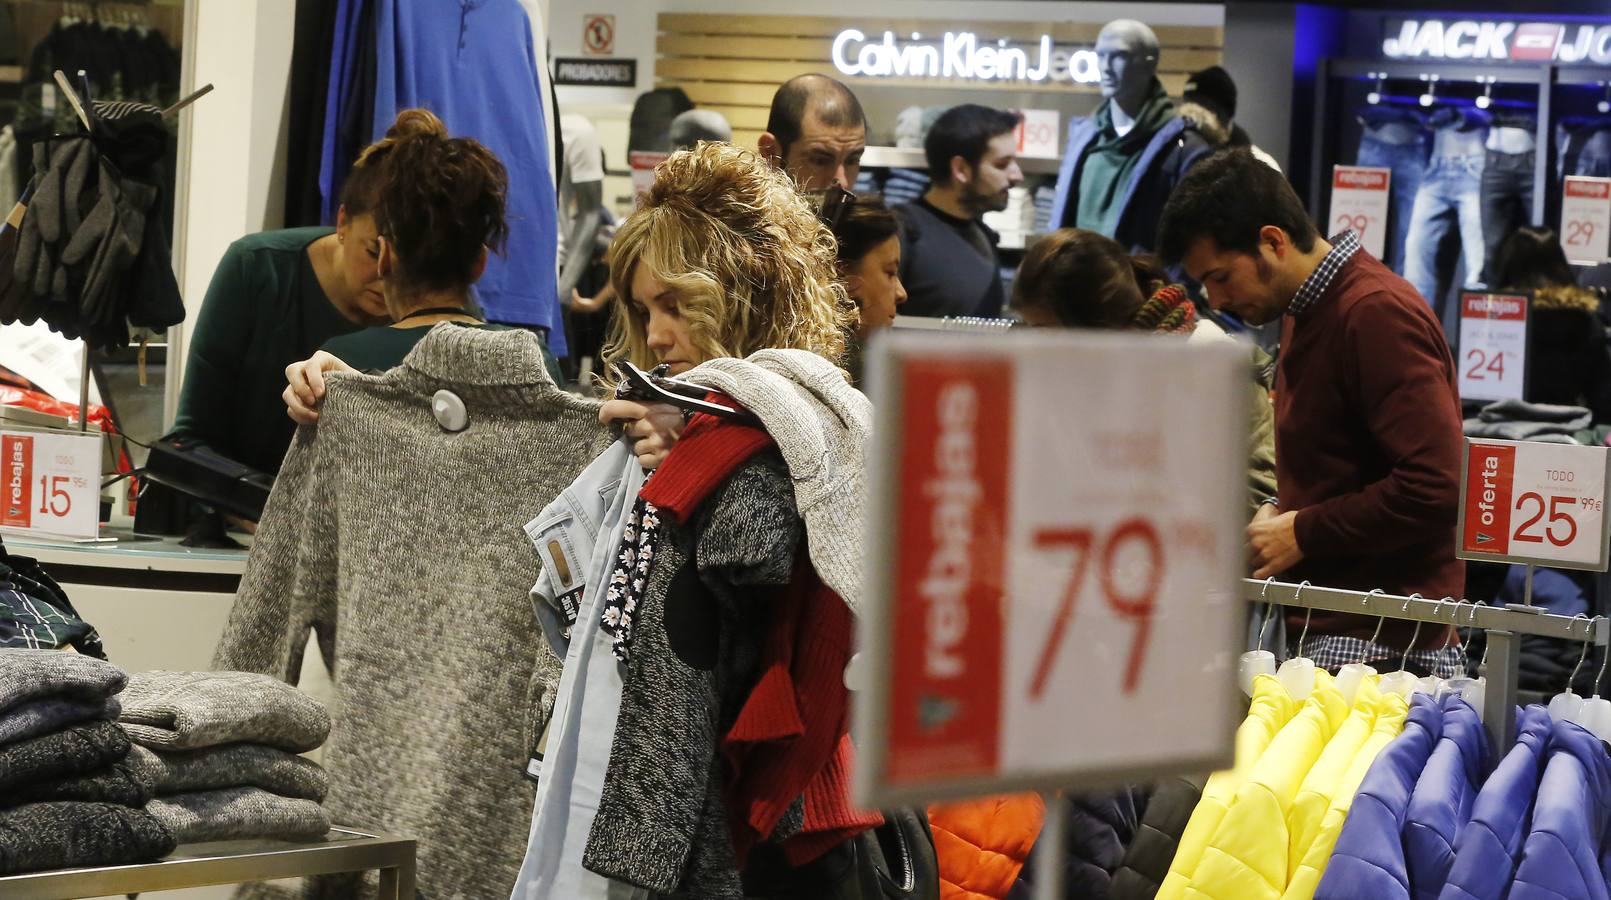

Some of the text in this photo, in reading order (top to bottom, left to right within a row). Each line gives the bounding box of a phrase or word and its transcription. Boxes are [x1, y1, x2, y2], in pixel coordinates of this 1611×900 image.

[832, 29, 939, 76] Calvin
[943, 31, 1027, 80] Klein
[1383, 19, 1515, 59] JACK
[1567, 220, 1595, 246] 29
[1468, 298, 1521, 315] rebajas
[1466, 348, 1505, 381] 24
[10, 441, 25, 505] rebajas
[40, 475, 71, 517] 15
[1478, 456, 1499, 526] oferta
[1546, 469, 1574, 482] TODO
[917, 382, 984, 680] rebajas
[1513, 491, 1577, 547] 25
[1027, 516, 1166, 702] 79
